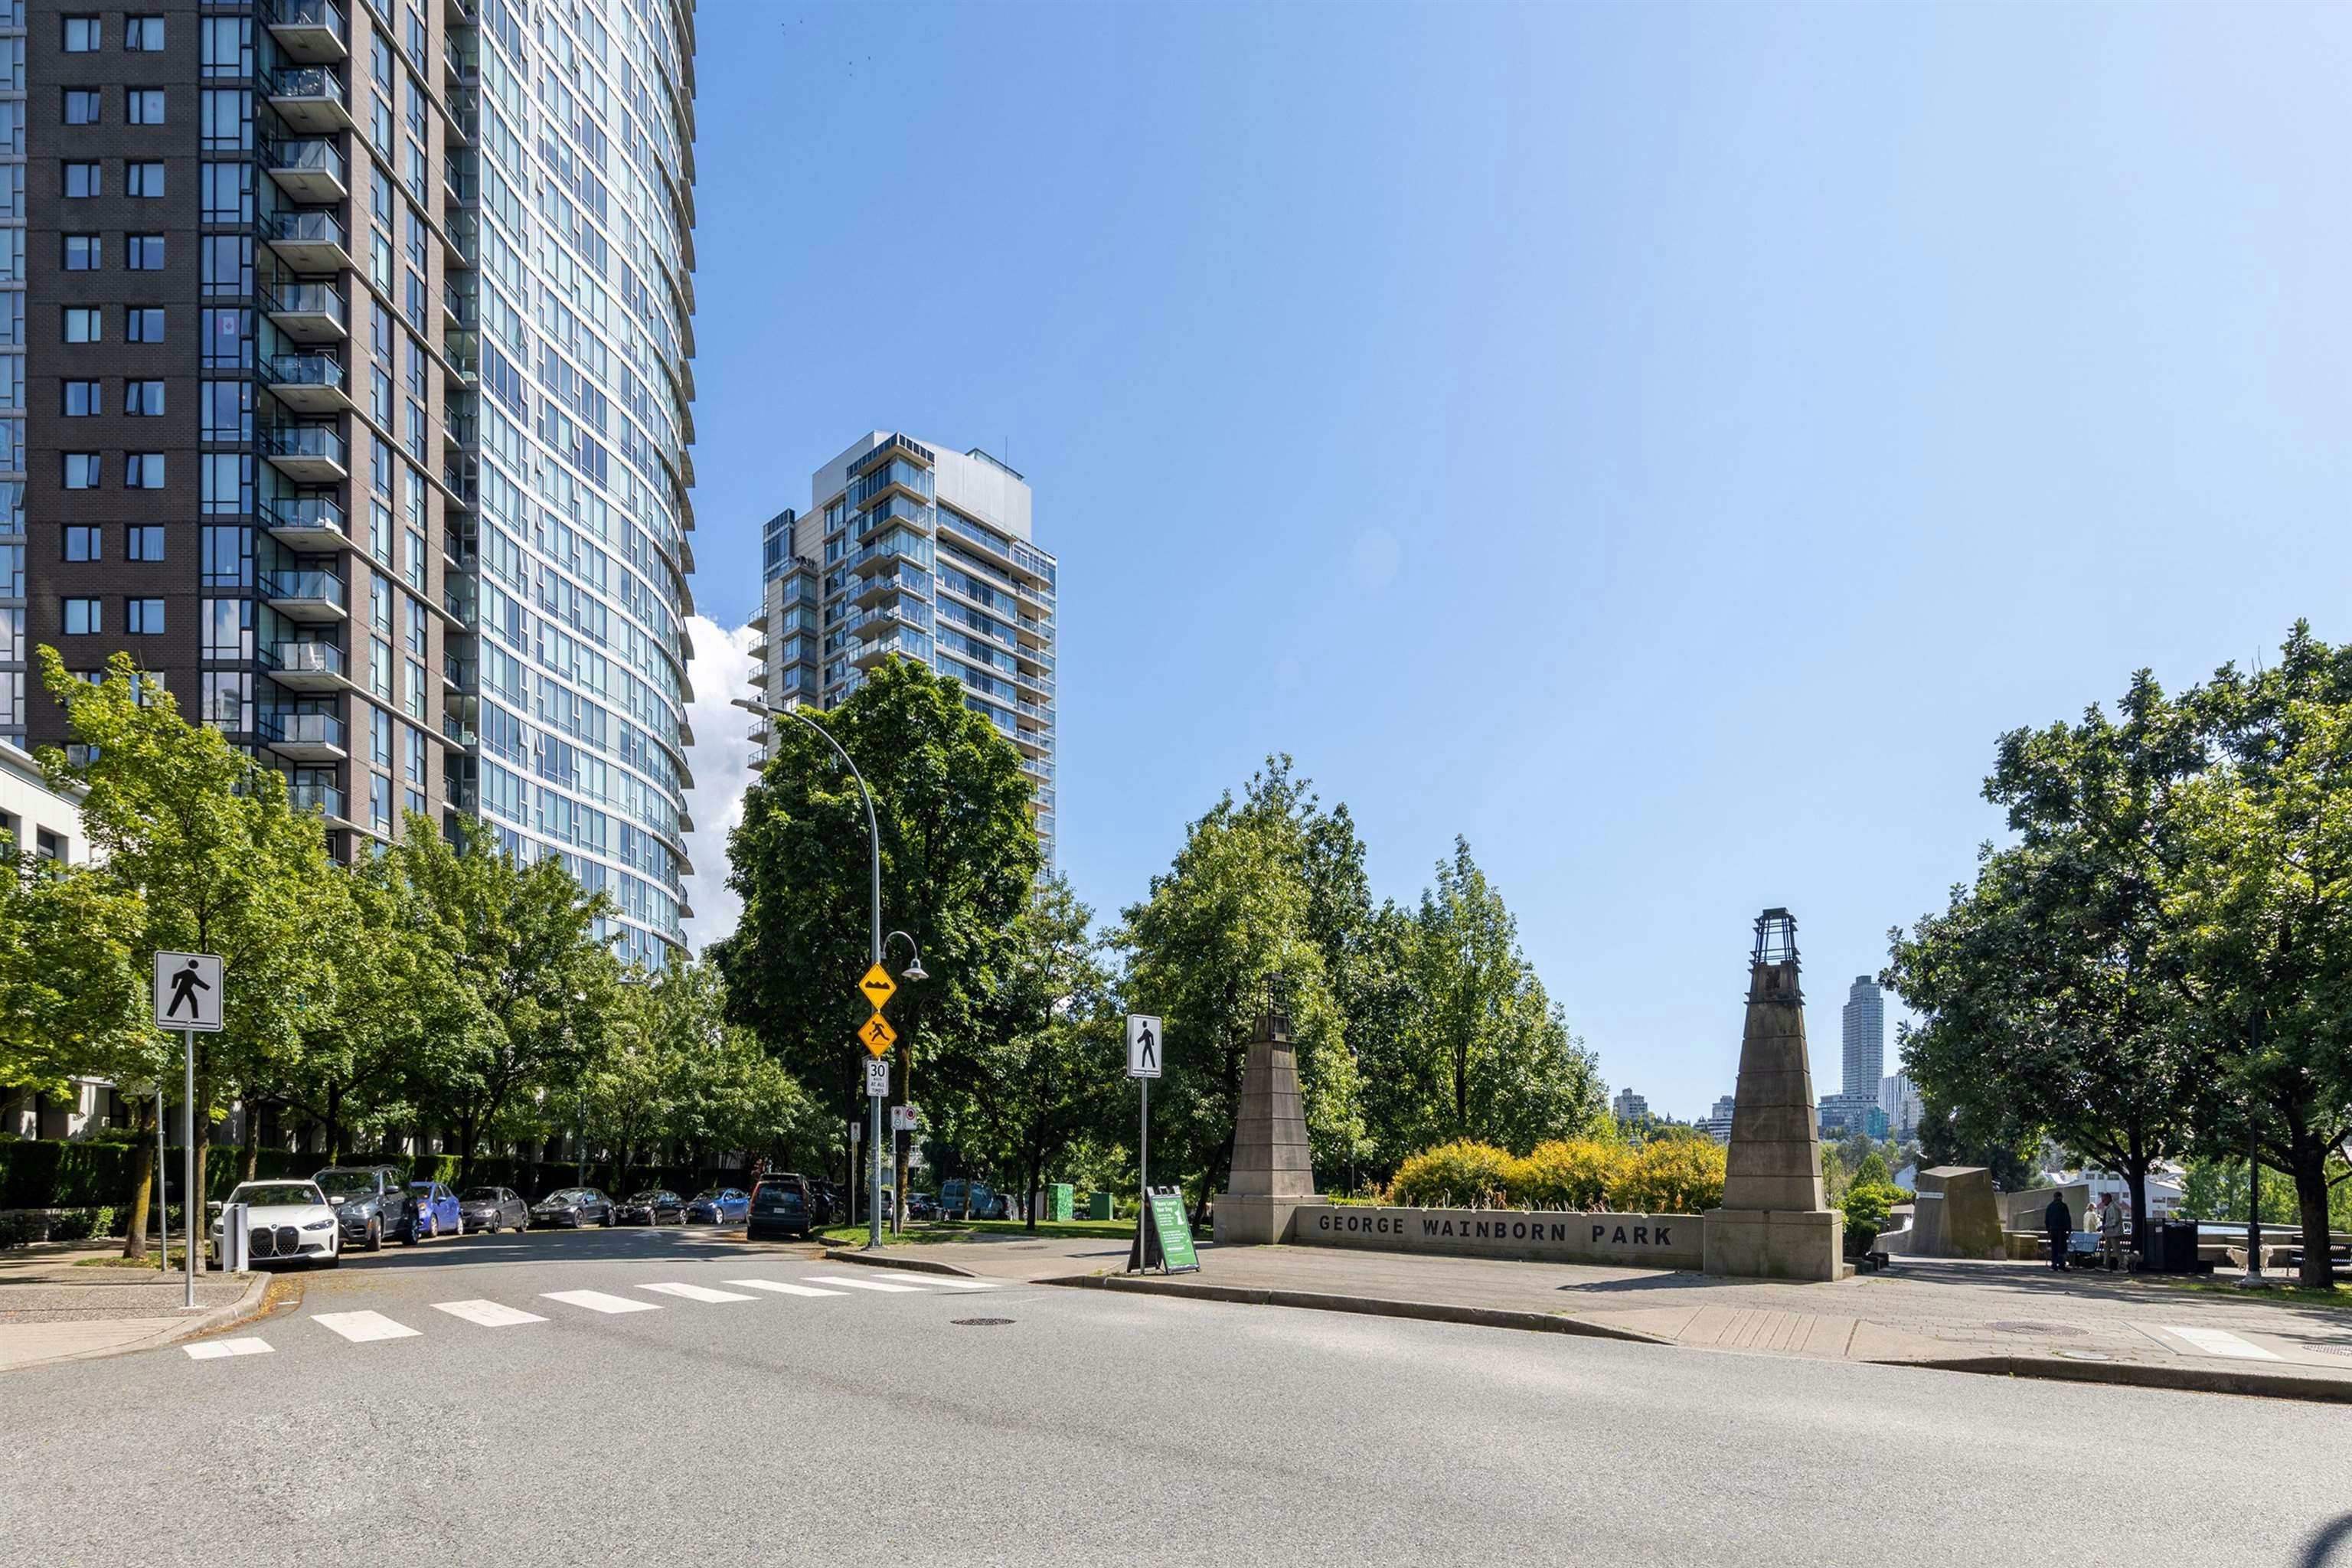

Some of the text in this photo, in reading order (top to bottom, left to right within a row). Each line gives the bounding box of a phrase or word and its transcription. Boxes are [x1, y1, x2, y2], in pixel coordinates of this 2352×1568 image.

[871, 1064, 885, 1077] 30
[1318, 1214, 1673, 1246] GEORGE WAINBORN PARK
